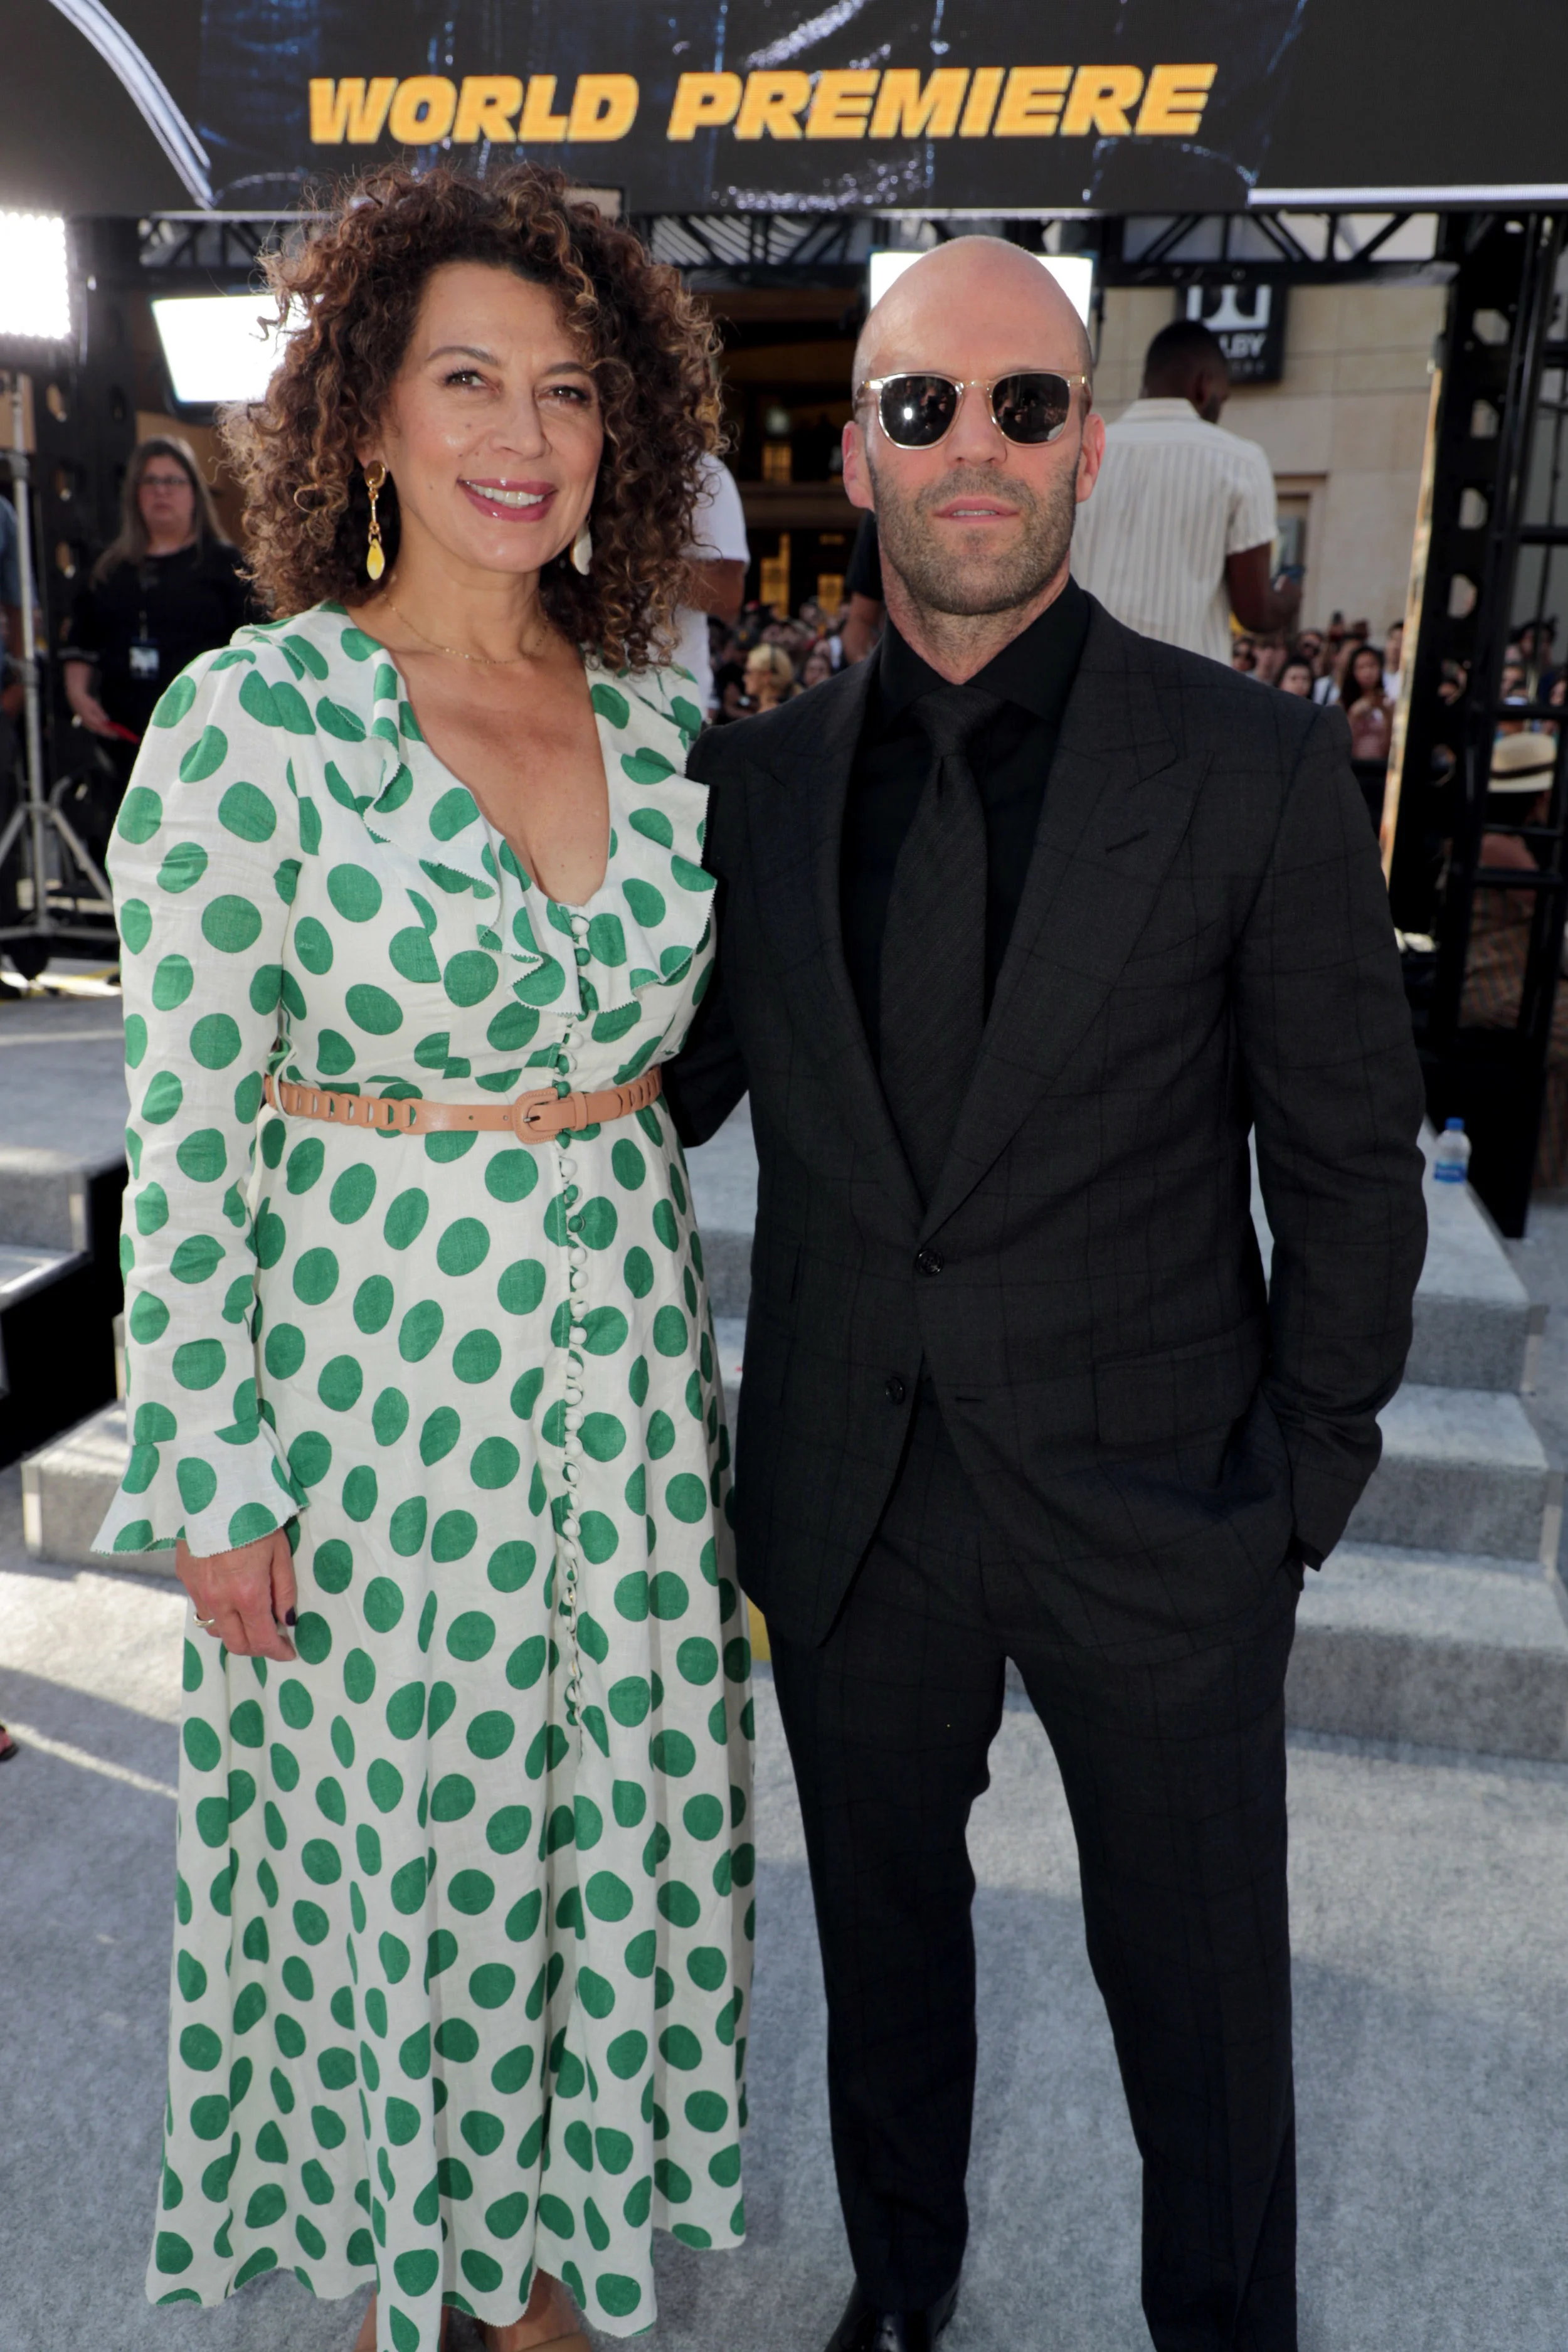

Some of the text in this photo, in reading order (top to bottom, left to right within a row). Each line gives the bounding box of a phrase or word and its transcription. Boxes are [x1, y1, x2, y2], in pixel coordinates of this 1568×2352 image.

[309, 63, 1217, 145] WORLD PREMIERE
[1219, 332, 1266, 359] LBY
